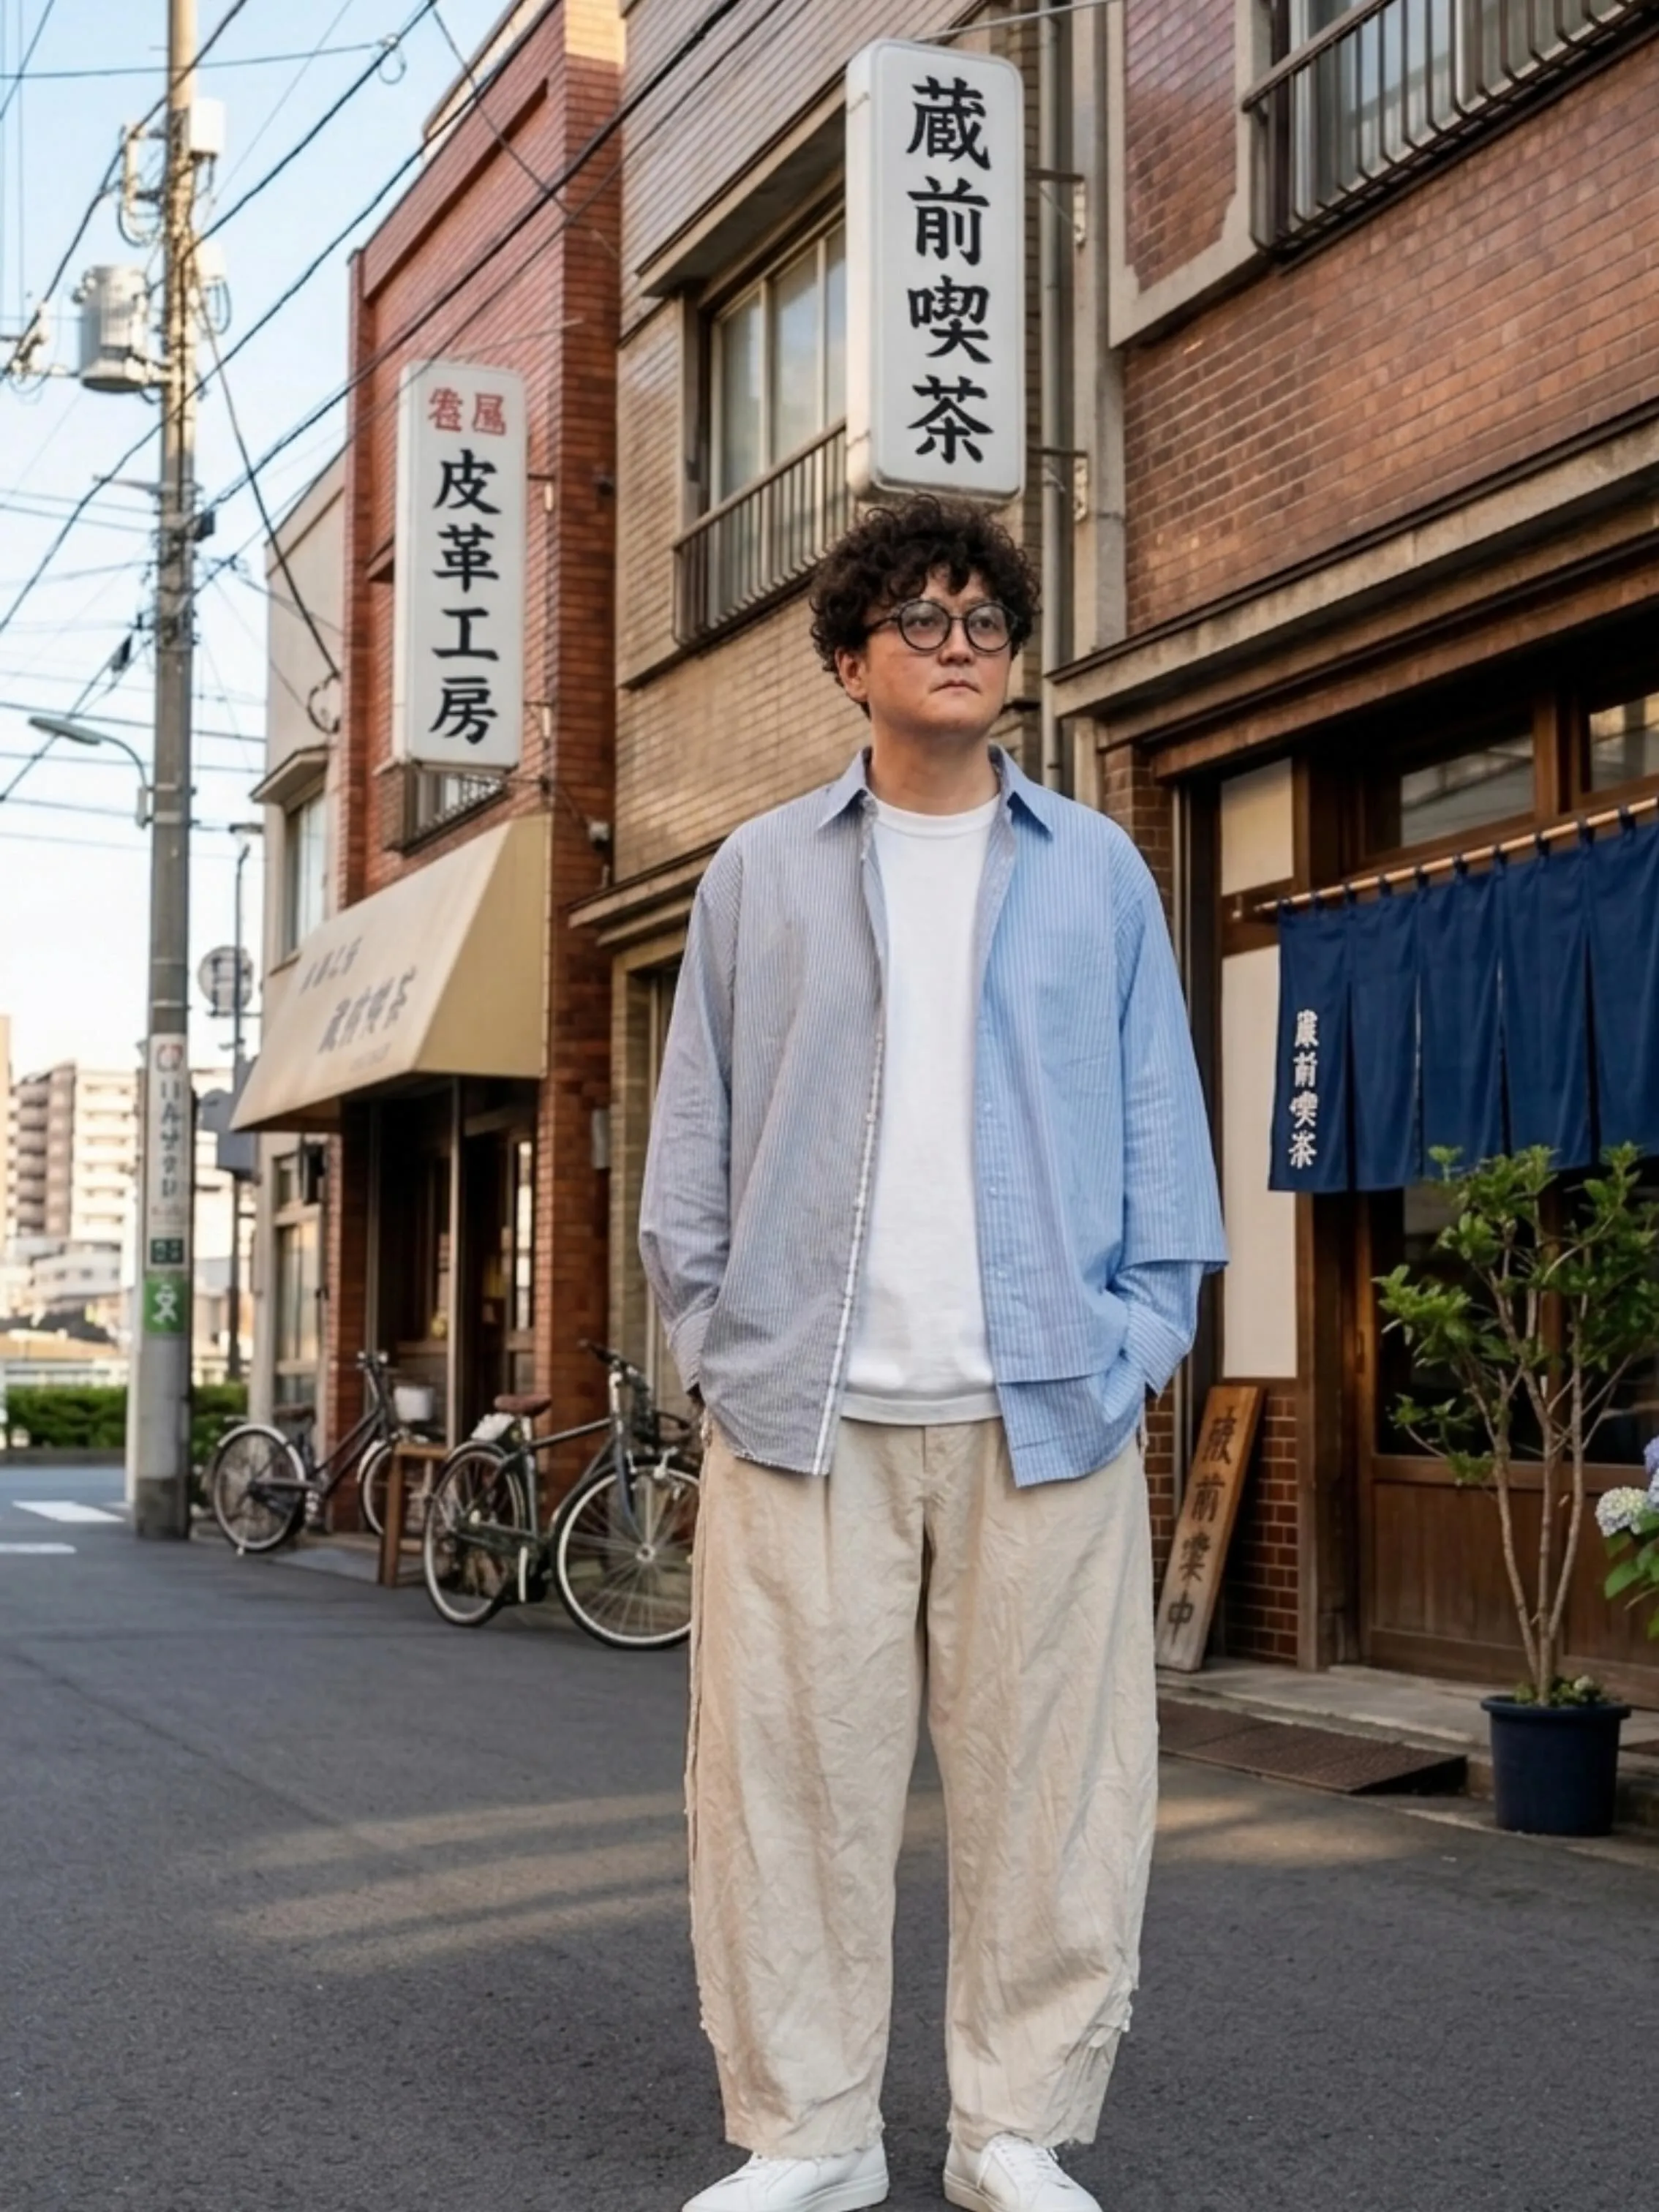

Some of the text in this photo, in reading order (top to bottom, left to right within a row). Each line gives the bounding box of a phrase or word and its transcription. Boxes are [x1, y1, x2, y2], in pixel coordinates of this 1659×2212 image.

[906, 75, 993, 464] 蔵前喫茶
[429, 448, 501, 745] 皮革工房
